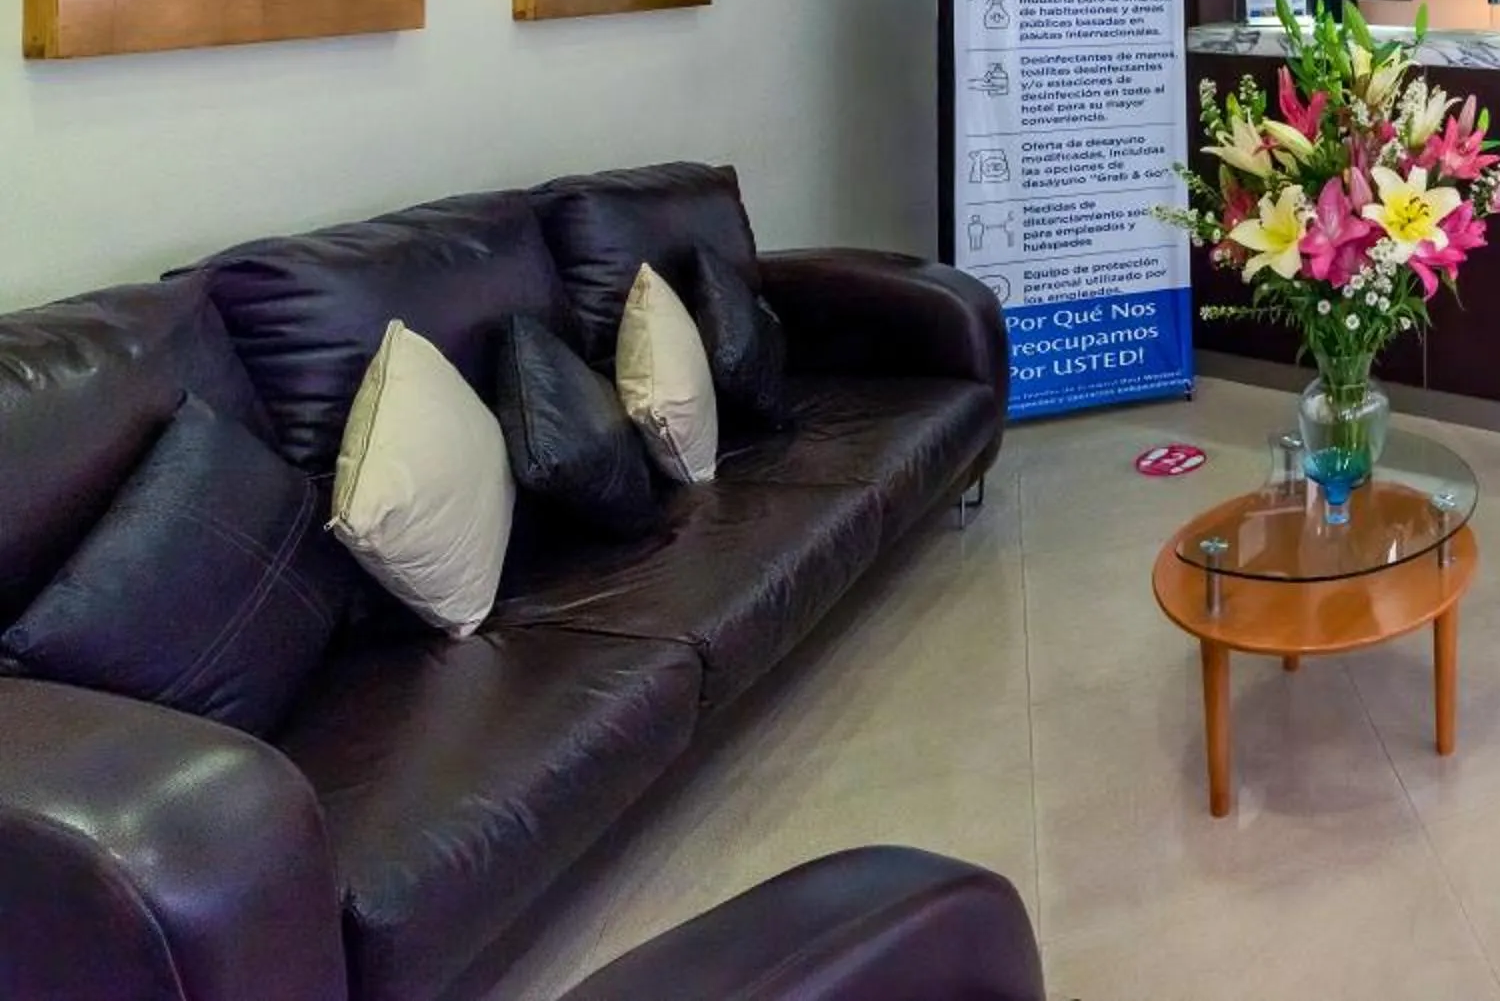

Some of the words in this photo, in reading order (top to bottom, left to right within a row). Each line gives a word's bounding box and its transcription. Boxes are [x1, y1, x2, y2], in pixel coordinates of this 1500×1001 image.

[1019, 6, 1037, 16] de
[1039, 5, 1119, 15] habitaciones
[1121, 6, 1129, 15] y
[1129, 17, 1145, 25] en
[1020, 54, 1113, 65] Desinfectantes
[1116, 52, 1133, 61] de
[1073, 63, 1163, 74] desinfectantes
[1020, 79, 1043, 91] y/o
[1047, 76, 1113, 87] estaciones
[1116, 74, 1132, 84] de
[1103, 89, 1119, 97] en
[1122, 86, 1152, 96] todo
[1155, 83, 1165, 93] el
[1020, 102, 1054, 114] hotel
[1057, 102, 1086, 112] para
[1089, 102, 1103, 110] su
[1105, 99, 1145, 109] mayor
[1066, 138, 1082, 148] de
[1085, 135, 1146, 147] desayuno
[1021, 167, 1041, 176] las
[1043, 163, 1105, 175] opciones
[1107, 161, 1125, 170] de
[1021, 176, 1087, 188] desayuno
[1023, 202, 1077, 214] Medidas
[1079, 200, 1097, 210] de
[1023, 211, 1125, 227] distanciamiento
[1023, 229, 1053, 241] para
[1055, 222, 1125, 236] empleados
[1128, 222, 1136, 231] y
[1023, 268, 1070, 281] Equipo
[1073, 265, 1089, 275] de
[1023, 277, 1082, 294] personal
[1085, 270, 1142, 286] utilizado
[1145, 268, 1167, 280] por
[1005, 316, 1047, 333] Por
[1053, 306, 1103, 328] Qué
[1111, 301, 1157, 320] Nos
[1011, 326, 1159, 356] reocupamos
[1053, 348, 1145, 376] USTED!
